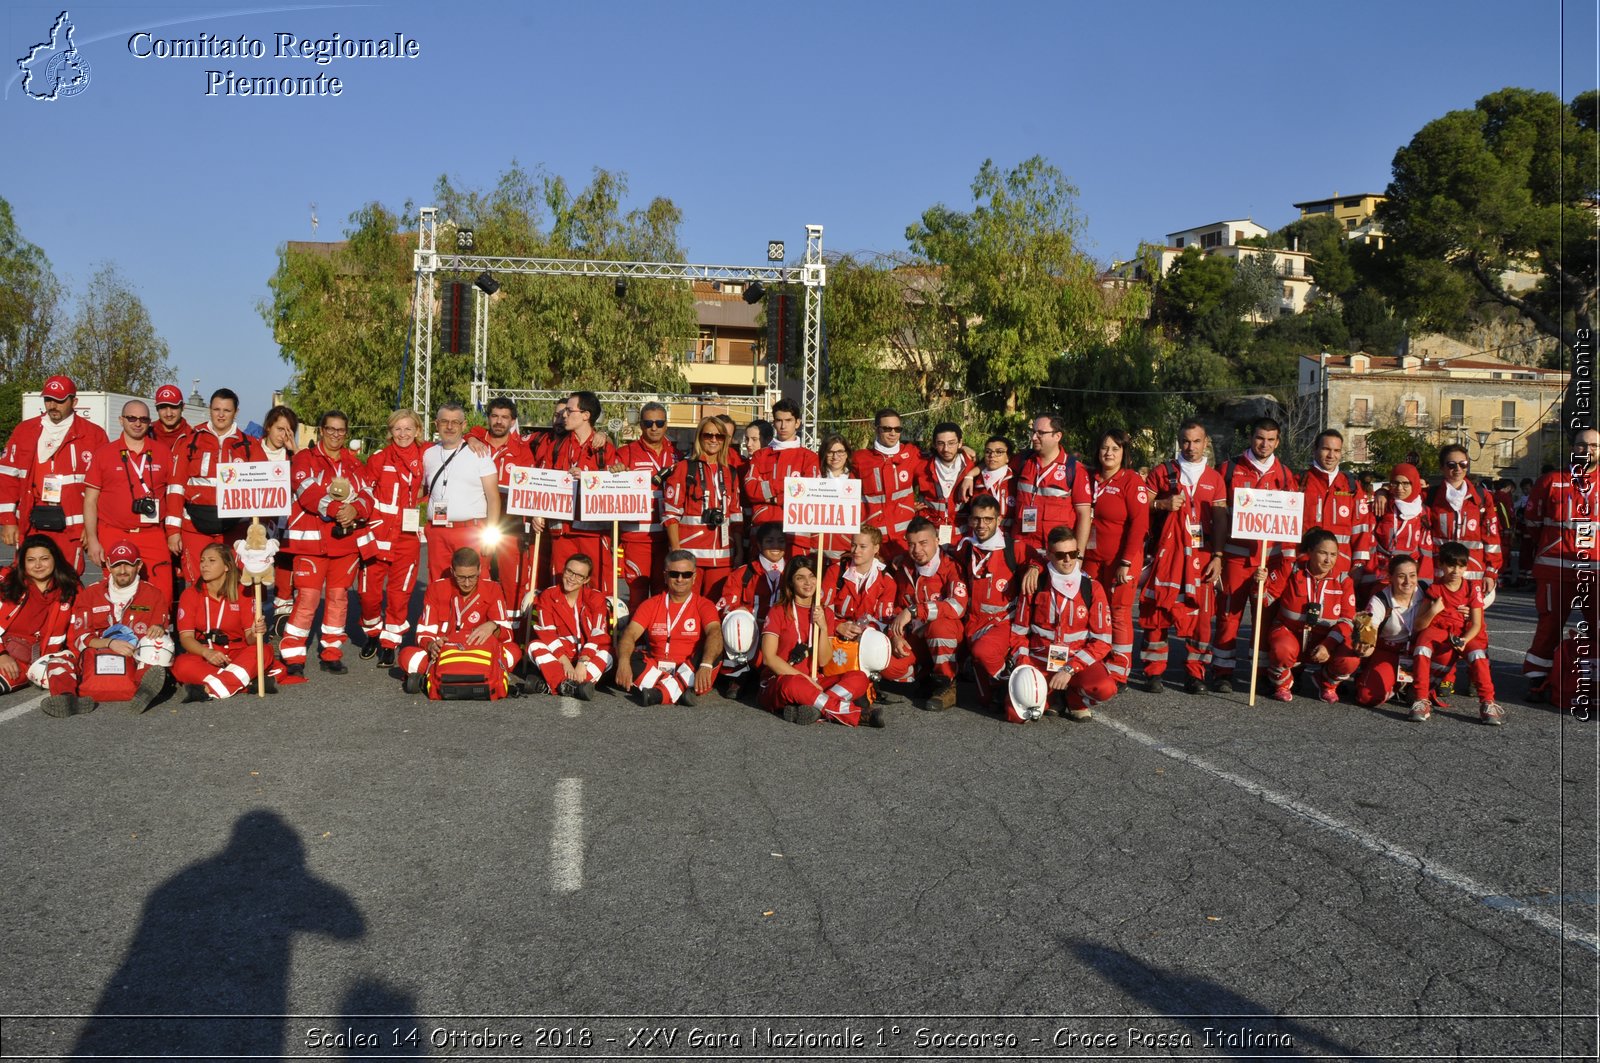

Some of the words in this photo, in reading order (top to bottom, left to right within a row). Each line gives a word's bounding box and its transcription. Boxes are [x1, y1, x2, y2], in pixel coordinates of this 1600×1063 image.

[221, 487, 287, 510] ABRUZZO
[511, 489, 573, 514] PIEMONTE
[585, 494, 648, 514] LOMBARDIA
[787, 503, 846, 526] SICILIA
[851, 505, 857, 526] 1
[1237, 512, 1299, 536] TOSCANA
